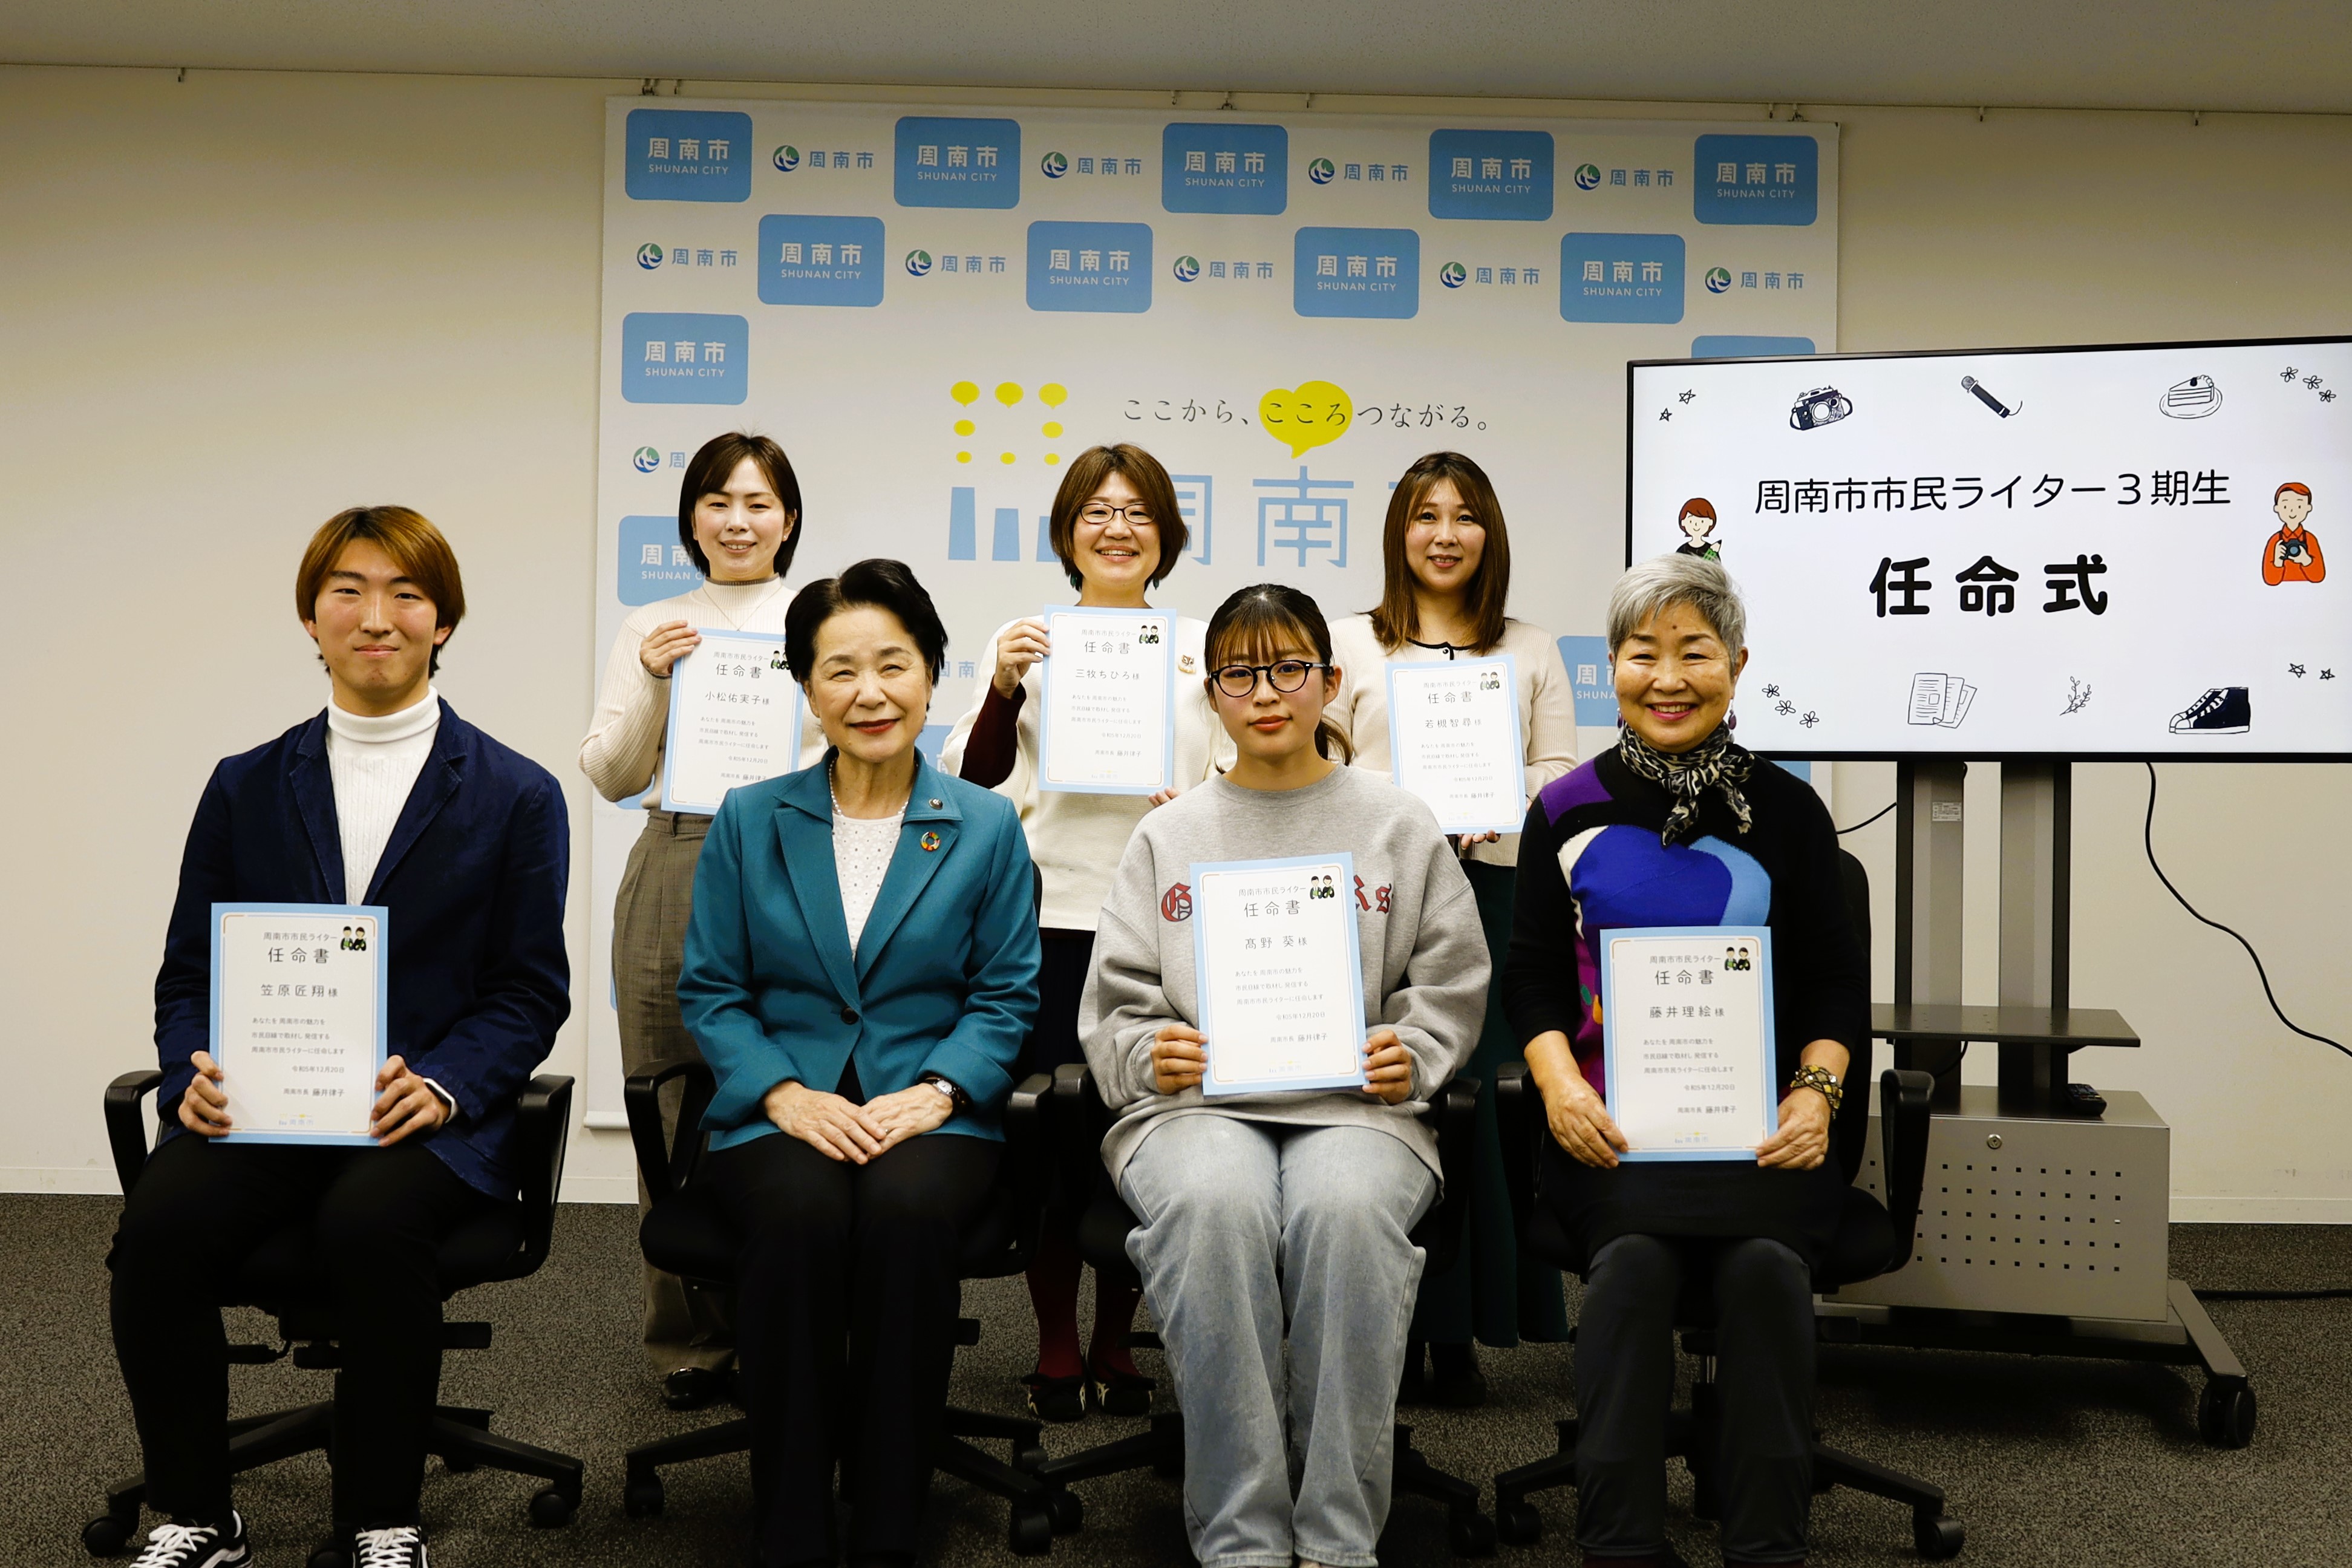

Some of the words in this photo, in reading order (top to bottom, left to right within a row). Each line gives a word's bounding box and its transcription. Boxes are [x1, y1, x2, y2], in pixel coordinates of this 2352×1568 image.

[648, 138, 729, 160] 周南市
[917, 145, 998, 168] 周南市
[809, 151, 874, 169] 周南市
[1077, 158, 1142, 175] 周南市
[1184, 151, 1265, 174] 周南市
[649, 165, 698, 174] SHUNAN
[918, 172, 965, 180] SHUNAN
[971, 172, 996, 181] CITY
[1344, 164, 1408, 181] 周南市
[1451, 158, 1531, 180] 周南市
[1716, 163, 1795, 184] 周南市
[1186, 177, 1233, 186] SHUNAN
[1238, 178, 1264, 187] CITY
[1610, 169, 1674, 187] 周南市
[1452, 184, 1500, 193] SHUNAN
[1505, 185, 1530, 194] CITY
[1717, 189, 1764, 197] SHUNAN
[1769, 189, 1794, 198] CITY
[672, 249, 737, 267] 周南市
[781, 243, 862, 266] 周南市
[1049, 250, 1130, 272] 周南市
[941, 256, 1005, 273] 周南市
[1209, 261, 1273, 279] 周南市
[1316, 255, 1397, 278] 周南市
[1583, 261, 1662, 283] 周南市
[782, 269, 829, 278] SHUNAN
[1050, 276, 1098, 285] SHUNAN
[1103, 277, 1129, 286] CITY
[1475, 267, 1540, 285] 周南市
[1741, 272, 1804, 290] 周南市
[1318, 282, 1365, 290] SHUNAN
[1584, 287, 1631, 296] SHUNAN
[1636, 288, 1661, 296] CITY
[645, 341, 725, 363] 周南市
[645, 368, 693, 376] SHUNAN
[699, 368, 724, 377] CITY
[641, 544, 691, 566] 周南
[641, 570, 691, 580] SHUNAN
[1869, 554, 2108, 618] 任命式
[1085, 641, 1130, 654] 任命書
[716, 663, 762, 679] 任命書
[1076, 669, 1140, 681] 三牧ちひろ様
[1428, 691, 1472, 704] 任命書
[1576, 690, 1617, 699] SHUNA
[1244, 900, 1301, 918] 任命書
[263, 932, 338, 941] 周南市市民ライター
[268, 947, 329, 964] 任命書
[1655, 969, 1714, 985] 任命書
[261, 984, 338, 997] 笠原匠翔様
[1649, 1005, 1725, 1018] 藤井理絵様
